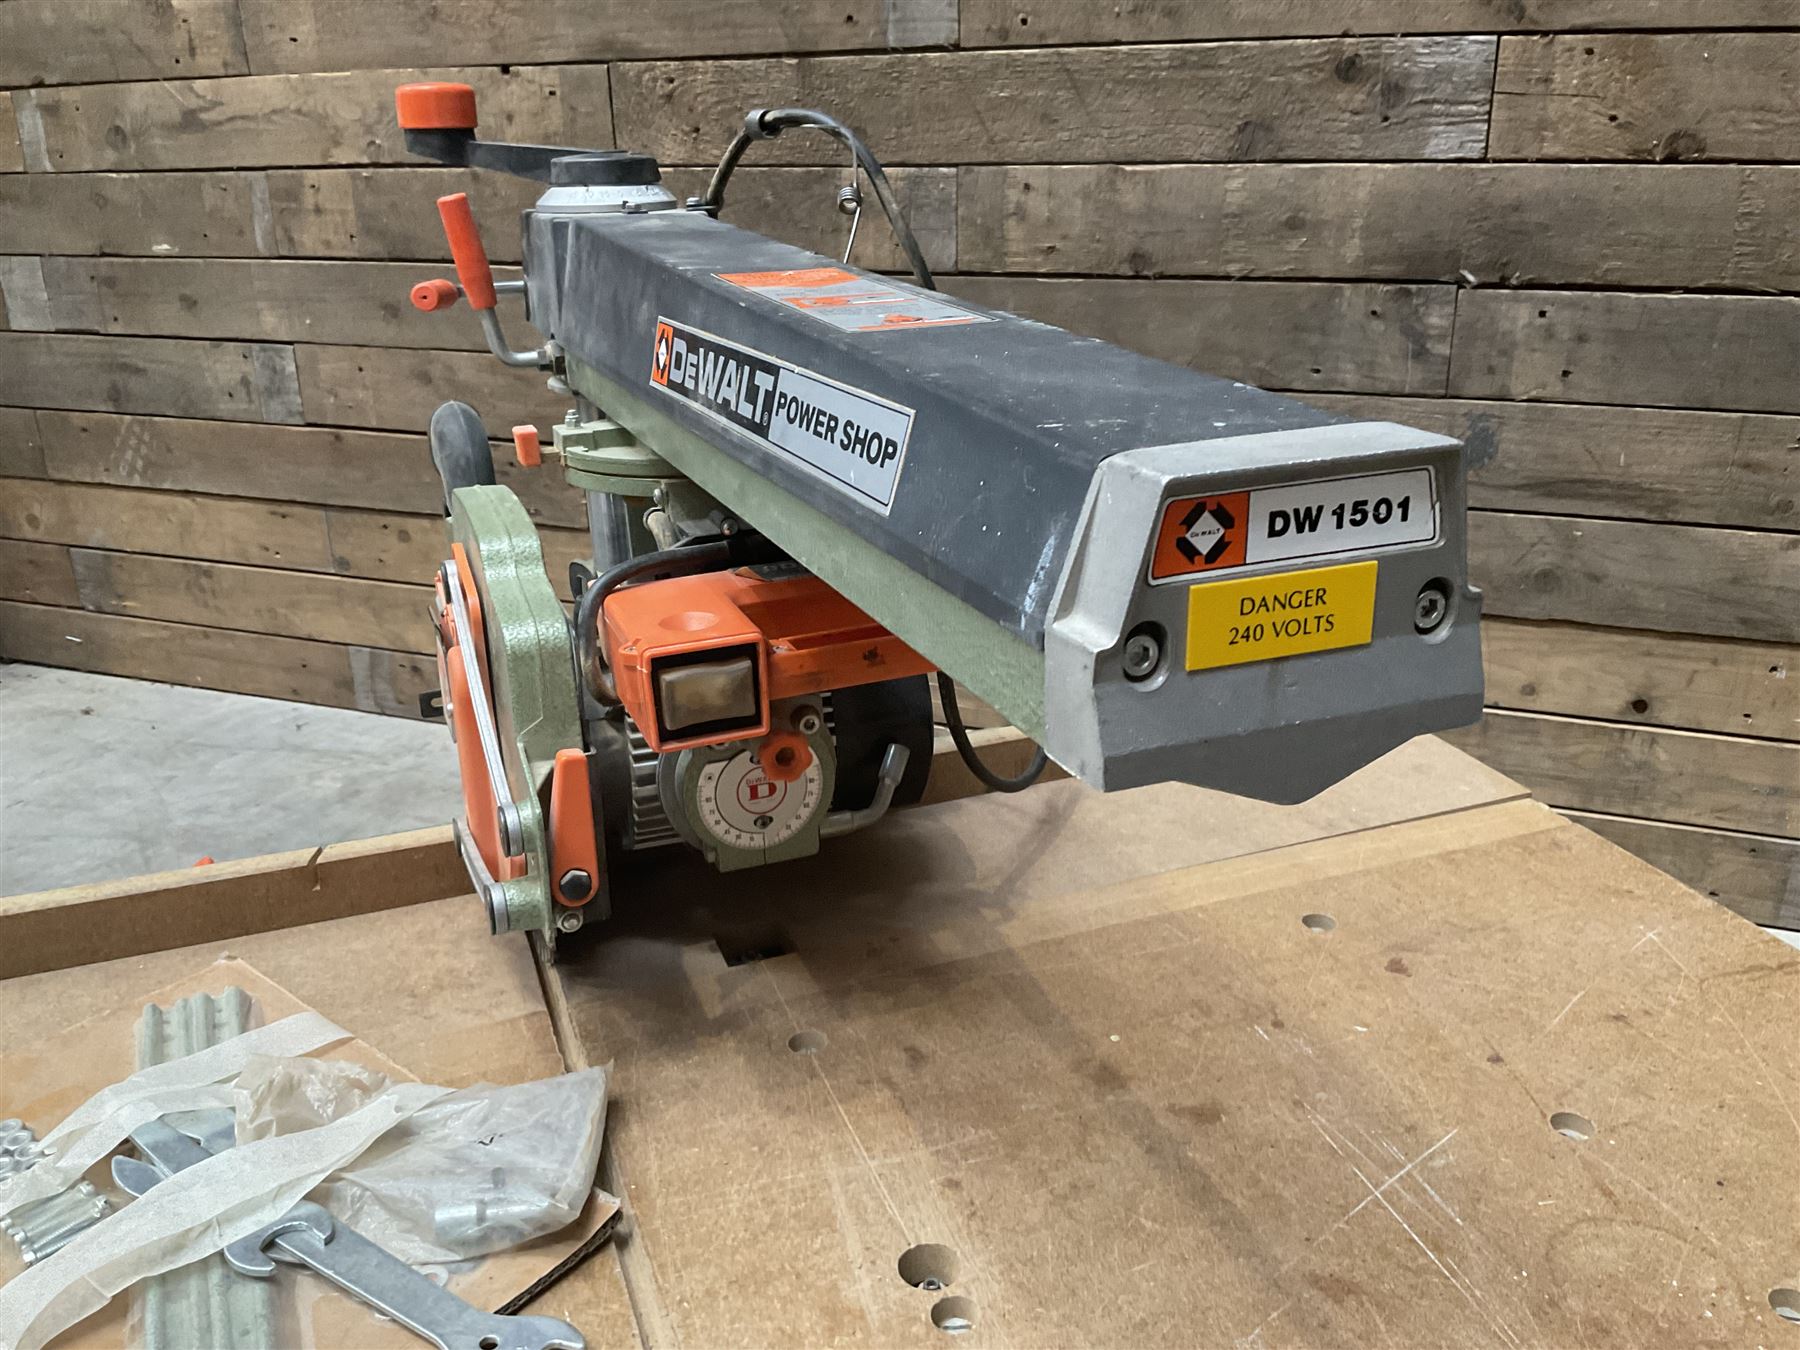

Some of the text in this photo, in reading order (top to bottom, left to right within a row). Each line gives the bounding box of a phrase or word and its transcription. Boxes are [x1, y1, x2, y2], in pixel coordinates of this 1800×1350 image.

[775, 390, 839, 444] POWER
[840, 419, 898, 468] SHOP
[1267, 495, 1411, 539] DW 1501
[1240, 587, 1327, 617] DANGER
[1228, 614, 1335, 646] 240 VOLTS
